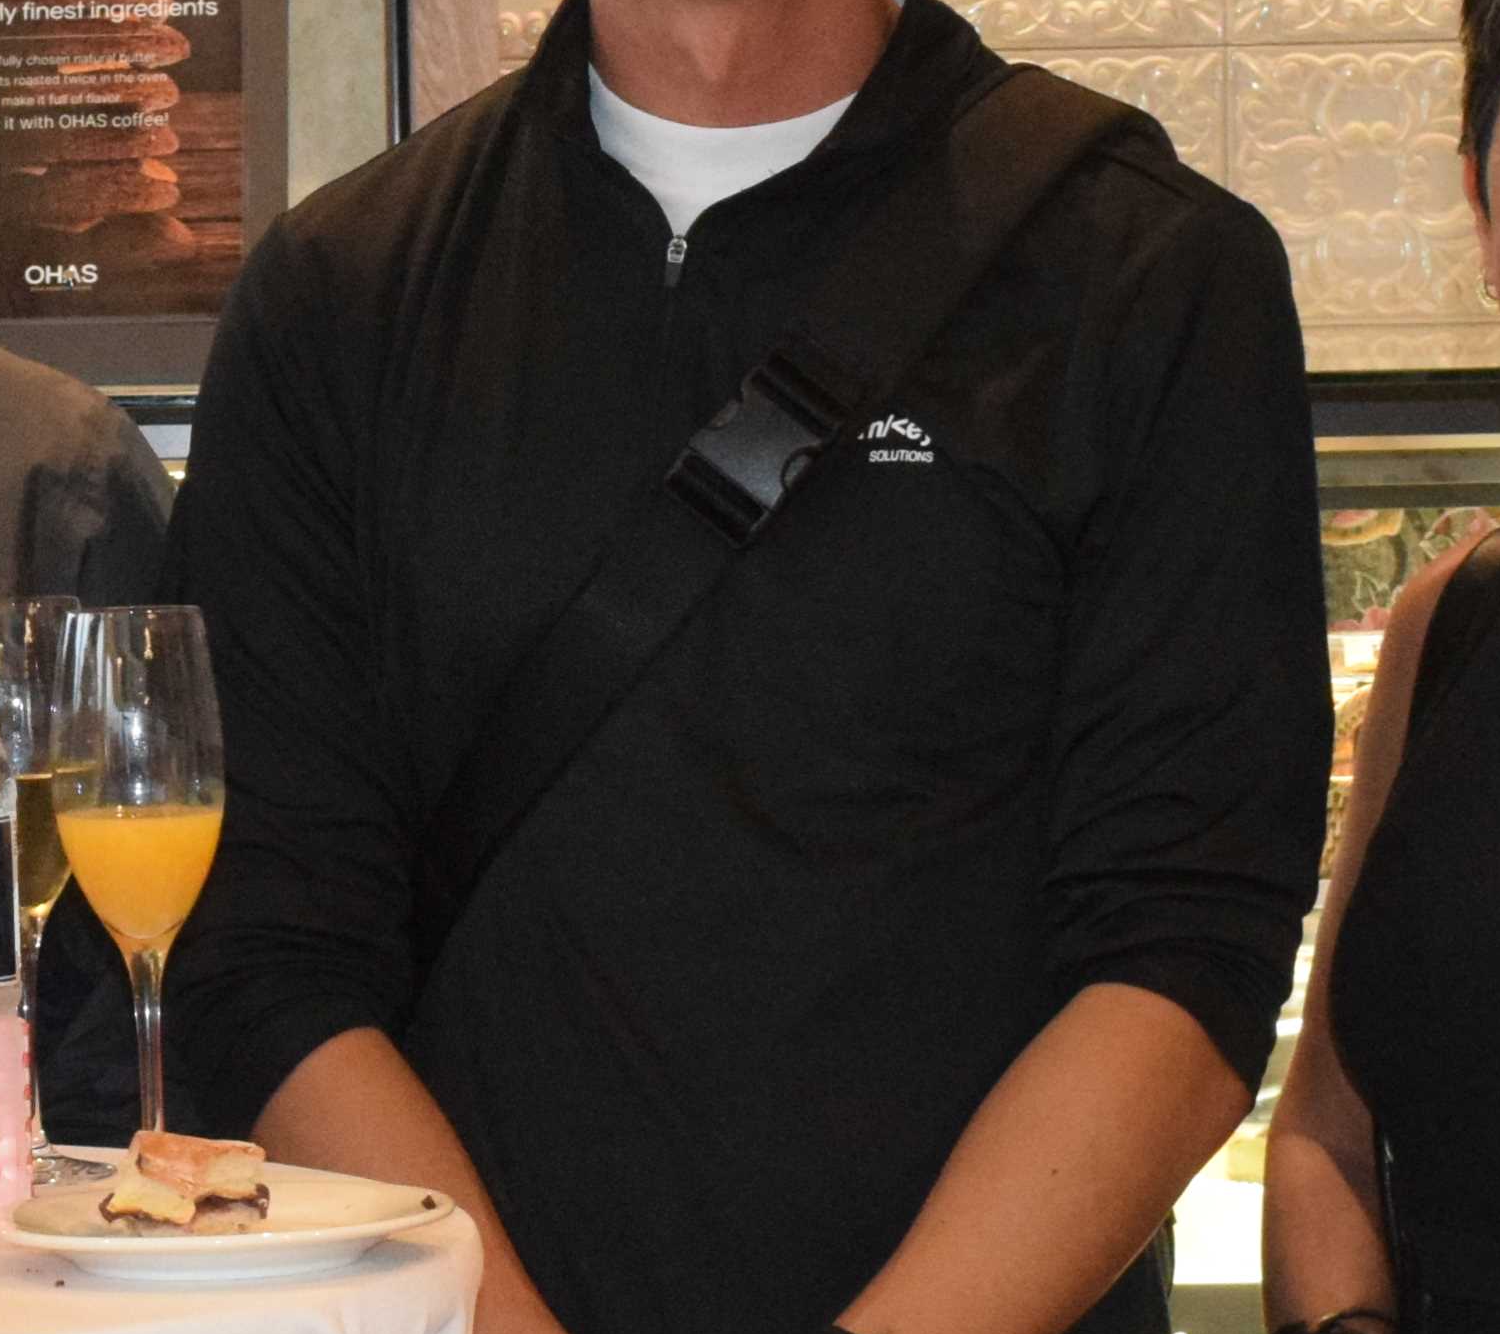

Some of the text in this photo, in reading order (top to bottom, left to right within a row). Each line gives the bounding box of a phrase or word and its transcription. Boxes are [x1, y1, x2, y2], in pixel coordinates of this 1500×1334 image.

[22, 1, 85, 22] finest
[26, 54, 70, 67] chosen
[73, 52, 116, 65] natural
[13, 74, 60, 87] roasted
[64, 73, 96, 85] twice
[101, 72, 111, 84] in
[114, 71, 135, 83] the
[137, 72, 168, 82] oven
[1, 94, 35, 107] make
[37, 94, 45, 106] it
[48, 93, 67, 105] full
[70, 93, 83, 105] of
[4, 115, 15, 131] it
[19, 114, 54, 130] with
[58, 113, 107, 129] OHAS
[112, 111, 169, 128] coffee!
[24, 264, 98, 285] OHAS
[868, 449, 935, 463] SOLUTIONS
